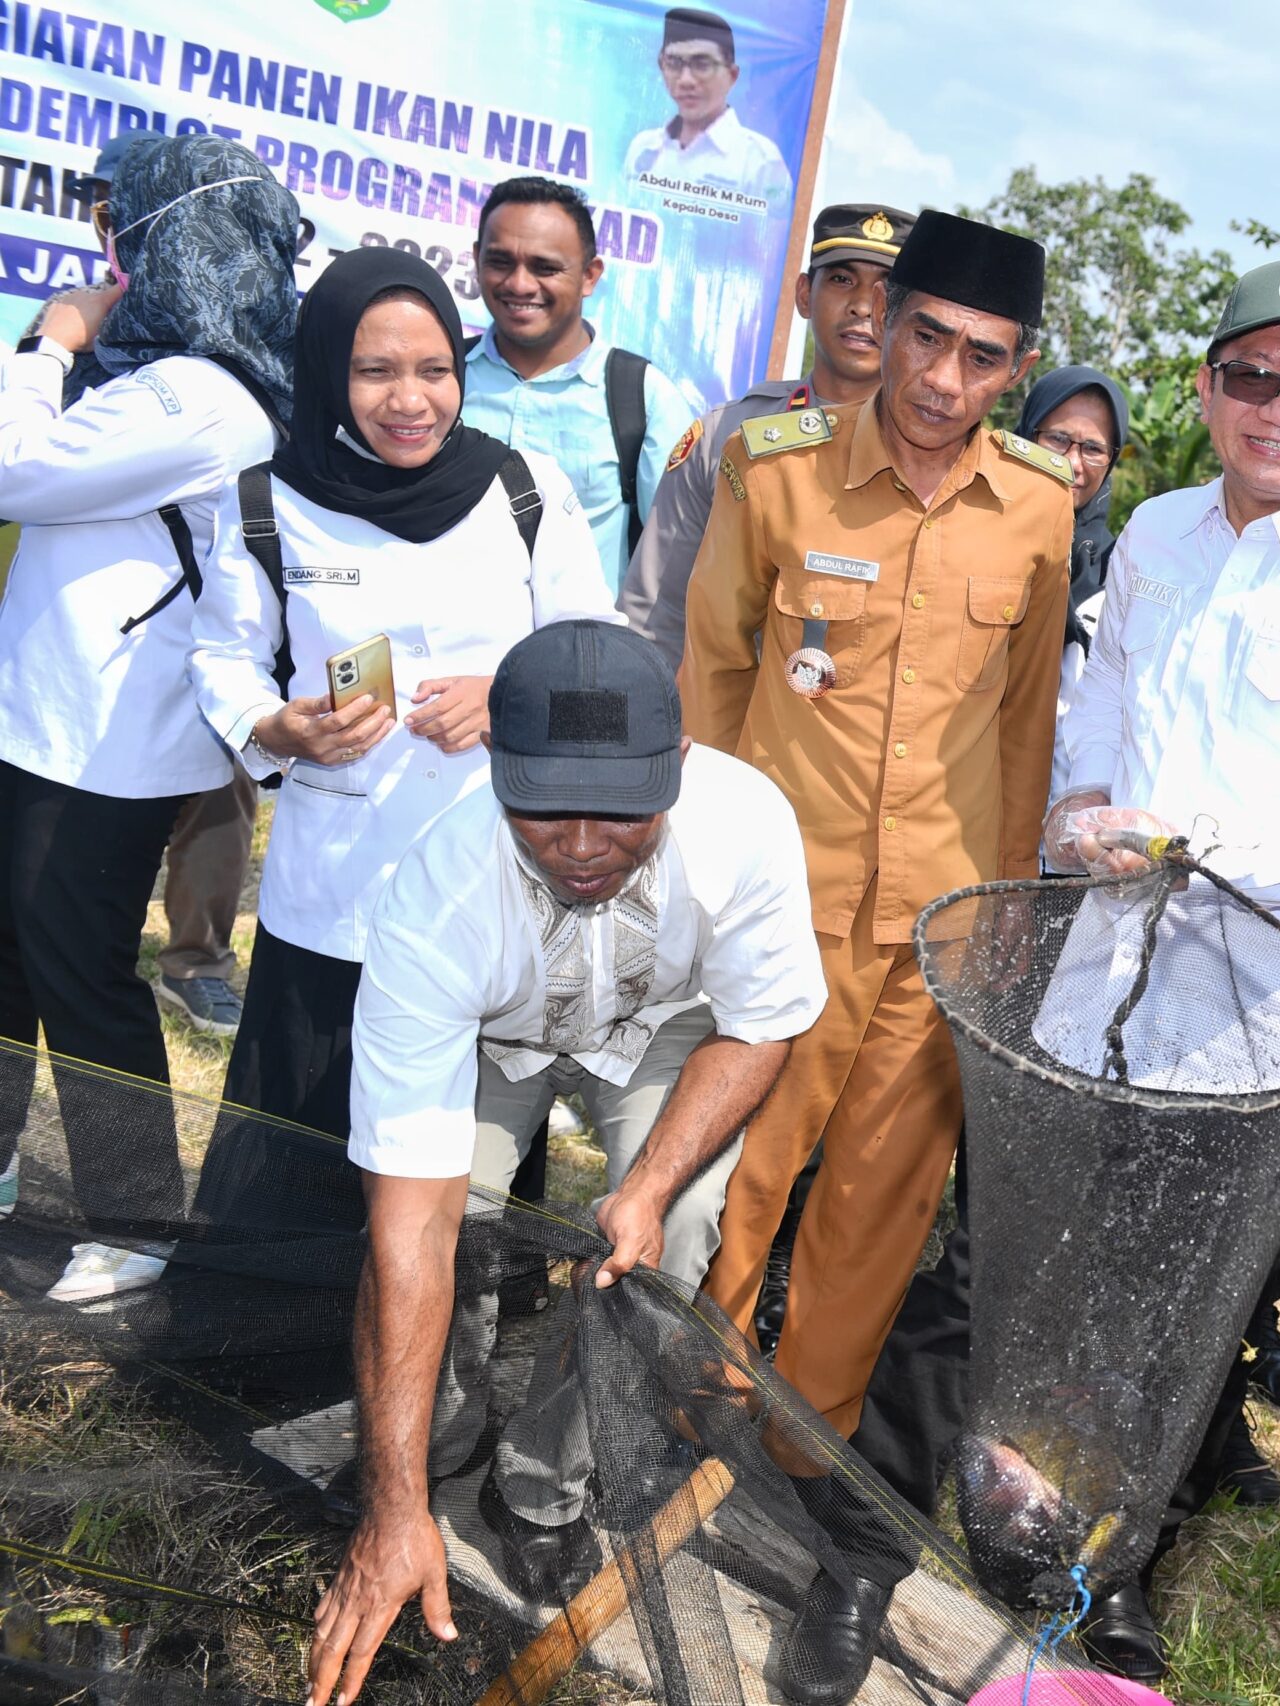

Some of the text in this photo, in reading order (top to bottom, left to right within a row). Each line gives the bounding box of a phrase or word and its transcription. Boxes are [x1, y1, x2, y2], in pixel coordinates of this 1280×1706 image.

[0, 77, 241, 148] DEMP
[179, 40, 342, 126] PANEN
[354, 82, 473, 154] IKAN
[484, 111, 588, 180] NILA
[639, 173, 767, 208] Abdul Rafik M Rum
[662, 198, 739, 221] Kepala Desa
[287, 570, 322, 580] ENDANG
[813, 558, 871, 576] ABDUL RAFIK
